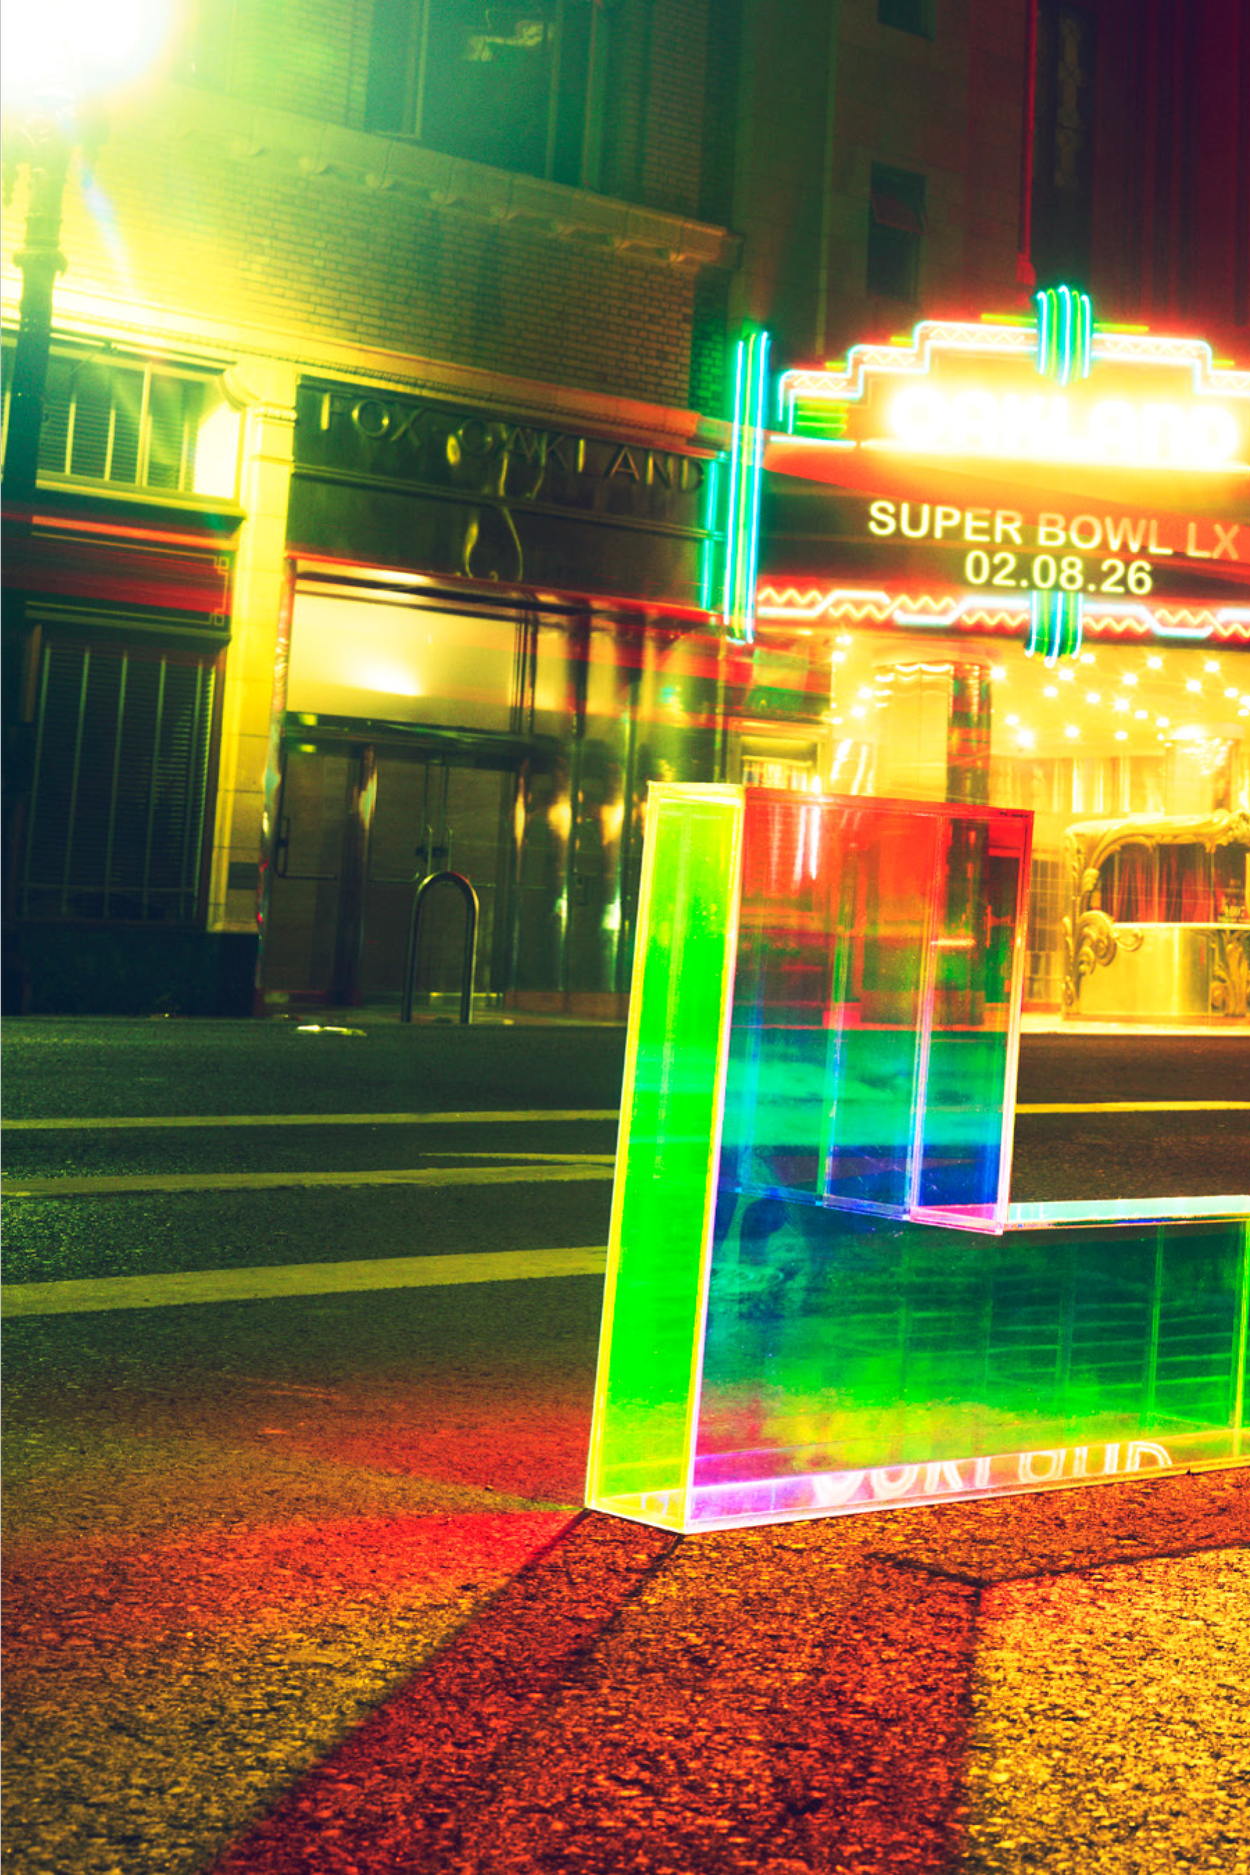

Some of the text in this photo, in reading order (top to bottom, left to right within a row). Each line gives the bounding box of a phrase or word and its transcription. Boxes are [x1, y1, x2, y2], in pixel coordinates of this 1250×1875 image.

[320, 392, 706, 491] FOX OAKLAND
[891, 385, 1238, 464] OAKLAND
[868, 500, 1240, 561] SUPER BOWL LX
[965, 550, 1153, 595] 02.08.26
